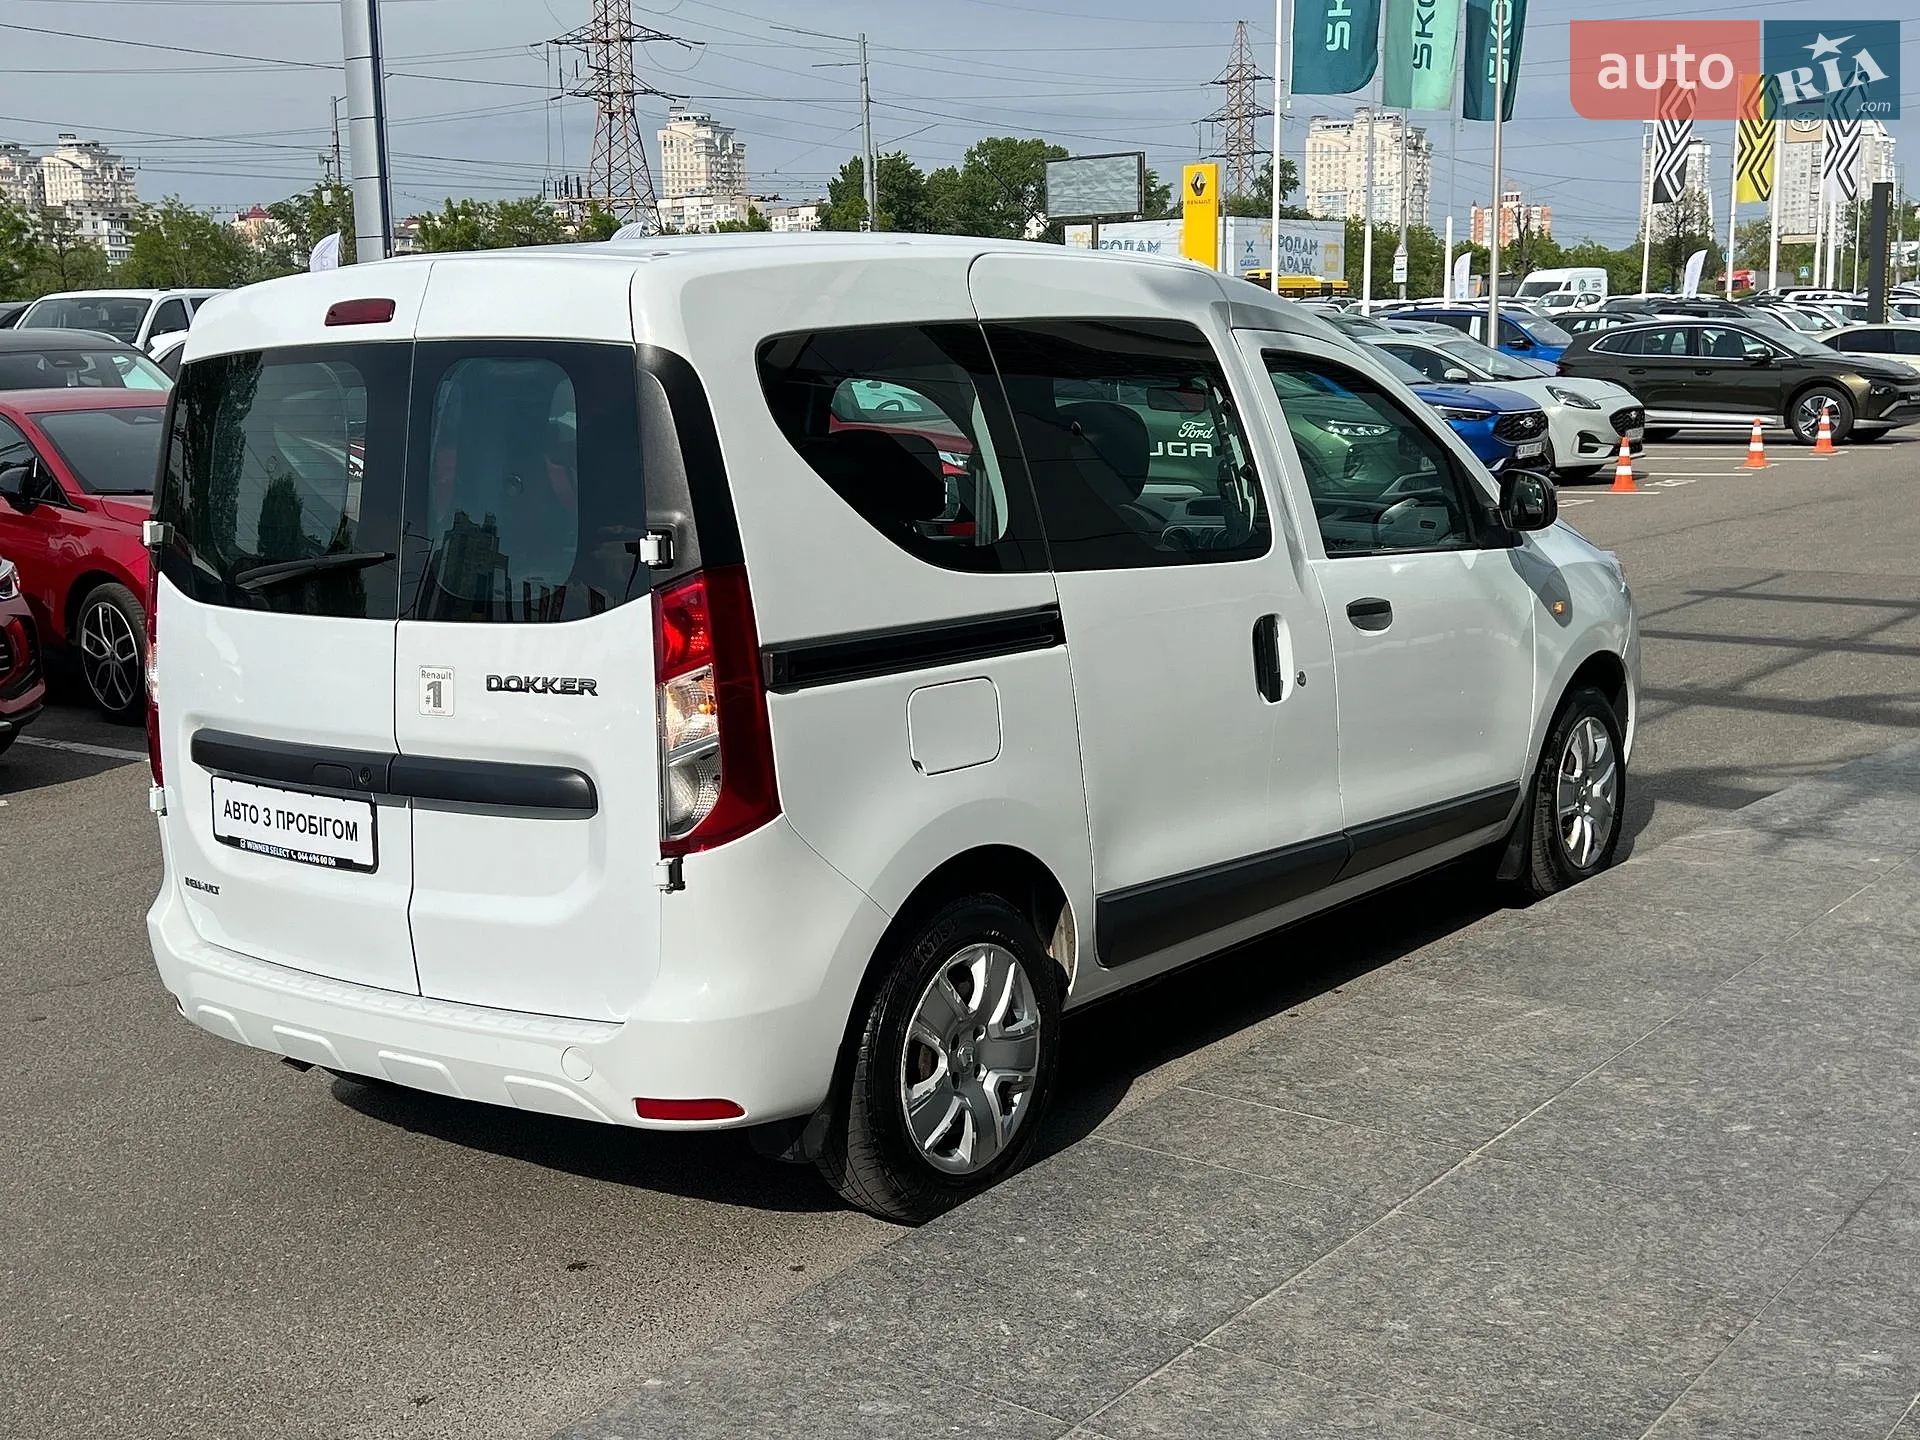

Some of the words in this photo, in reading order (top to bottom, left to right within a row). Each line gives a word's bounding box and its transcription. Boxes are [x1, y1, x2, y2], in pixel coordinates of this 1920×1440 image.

[1088, 239, 1161, 254] РОДАМ
[1270, 234, 1318, 256] РОДАМ
[1279, 255, 1312, 275] АРАЖ
[1178, 421, 1214, 438] Ford
[1149, 441, 1212, 457] UGA
[421, 670, 452, 680] Renault
[486, 674, 598, 696] DOKKER
[224, 800, 259, 824] АВТО
[276, 809, 358, 842] ПРОБІГОМ
[247, 841, 270, 854] WINNER
[269, 845, 289, 858] SELECT
